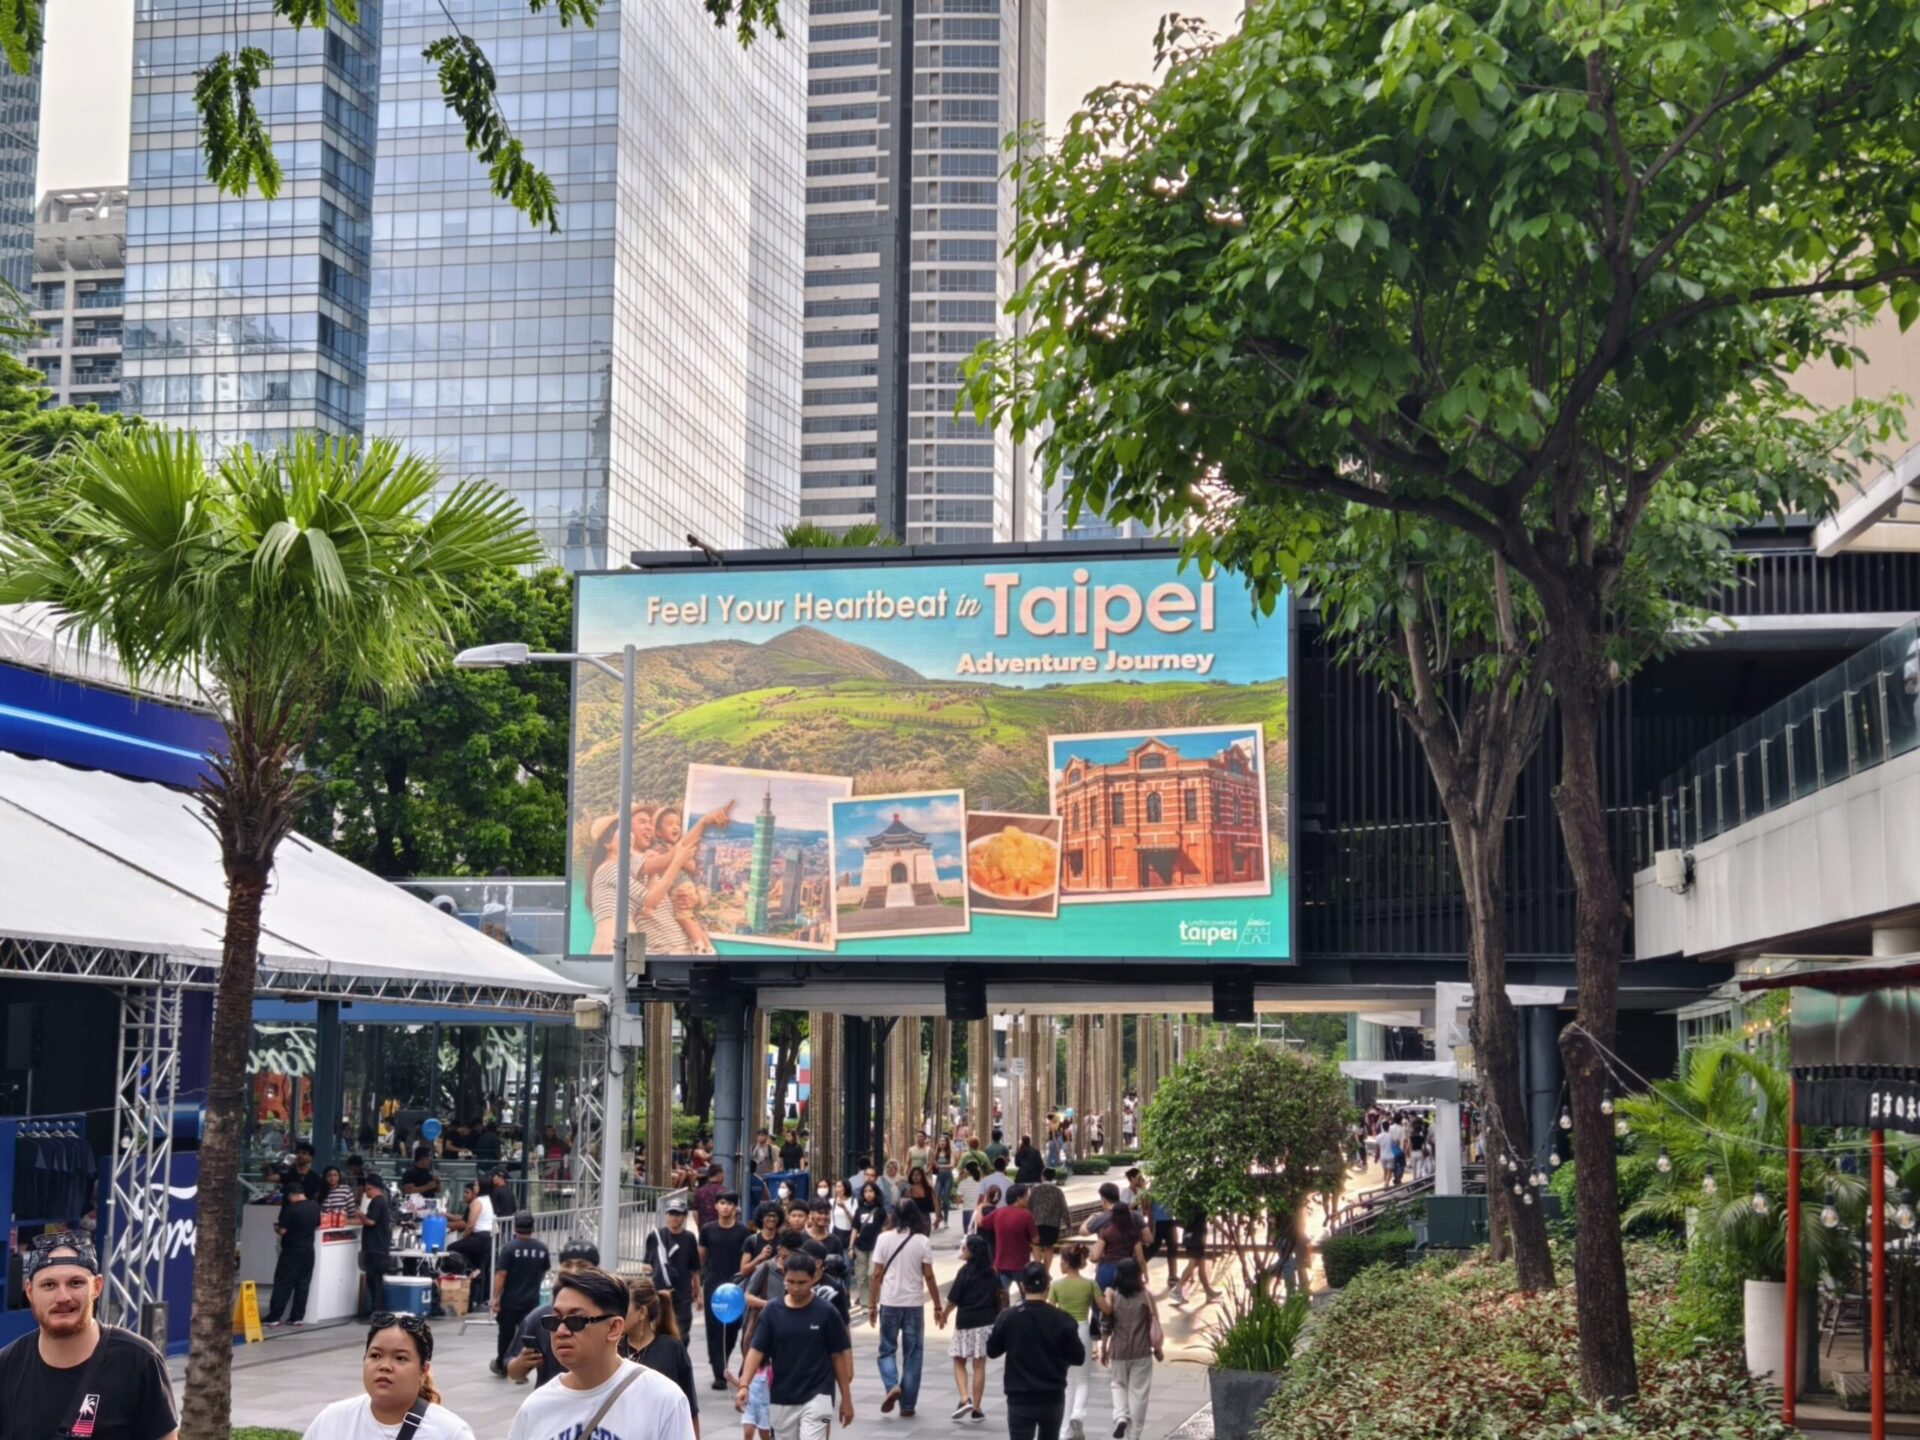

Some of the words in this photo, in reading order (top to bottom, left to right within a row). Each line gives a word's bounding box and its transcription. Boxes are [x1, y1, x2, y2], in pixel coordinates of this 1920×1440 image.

[647, 594, 707, 625] Feel
[716, 594, 785, 622] Your
[794, 587, 948, 621] Heartbeat
[955, 592, 982, 618] in
[984, 568, 1216, 650] Taipei
[956, 651, 1097, 674] Adventure
[1104, 650, 1215, 675] Journey
[1179, 919, 1238, 947] taipei
[120, 1183, 198, 1261] For
[514, 1248, 546, 1259] CREW
